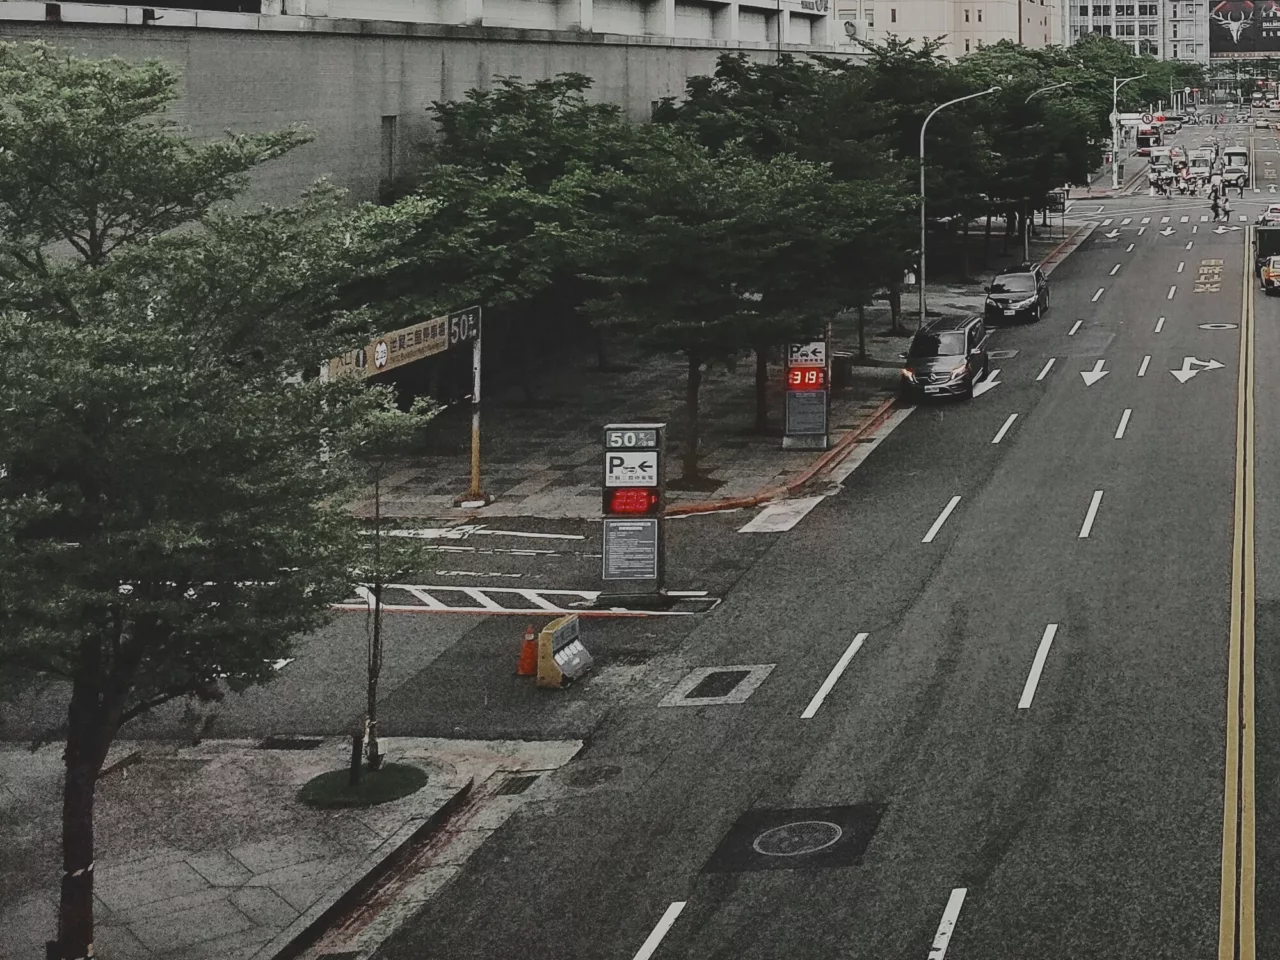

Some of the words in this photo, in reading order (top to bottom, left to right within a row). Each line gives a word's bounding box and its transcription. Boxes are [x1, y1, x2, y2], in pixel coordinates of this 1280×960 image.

[450, 314, 468, 344] 50
[793, 371, 817, 384] 319
[610, 432, 637, 447] 50
[609, 456, 625, 474] P
